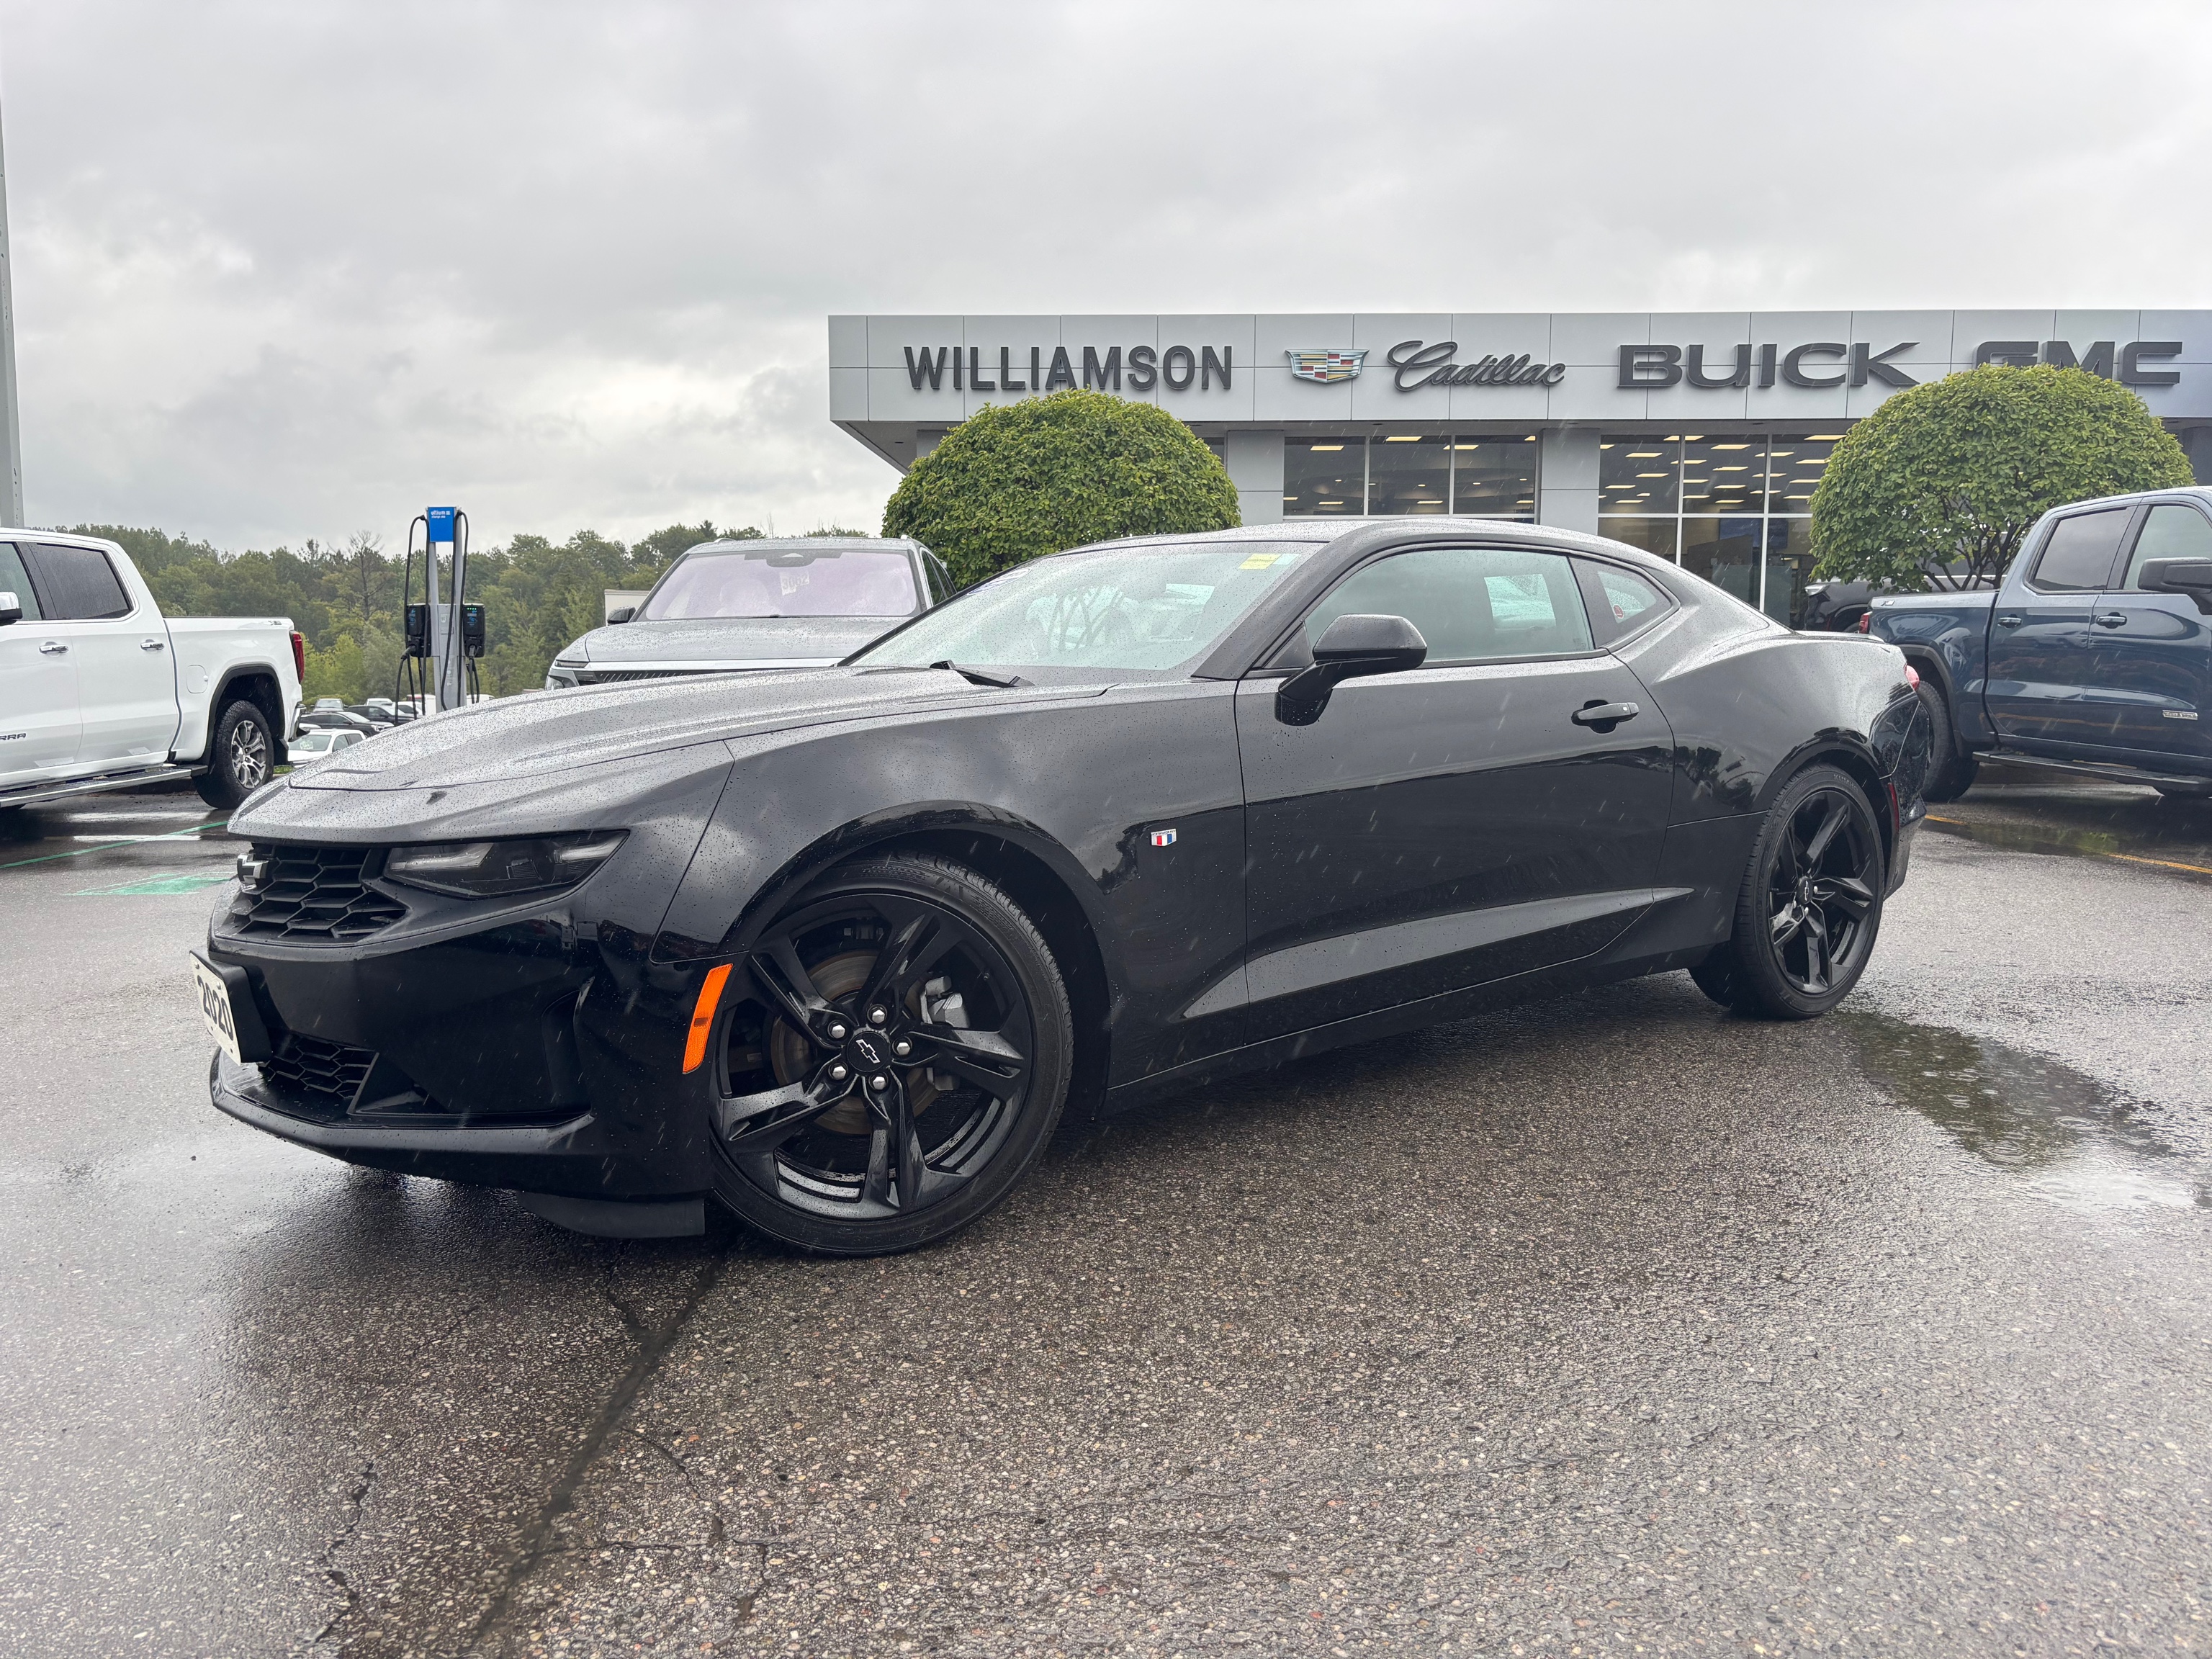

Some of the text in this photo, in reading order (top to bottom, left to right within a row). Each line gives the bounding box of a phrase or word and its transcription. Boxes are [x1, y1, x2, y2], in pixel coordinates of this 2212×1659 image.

[904, 346, 1232, 390] WILLIAMSON
[1387, 340, 1565, 391] Cadillac
[1617, 341, 1921, 387] BUICK
[1973, 341, 2183, 384] GMC
[197, 974, 234, 1041] 2020
